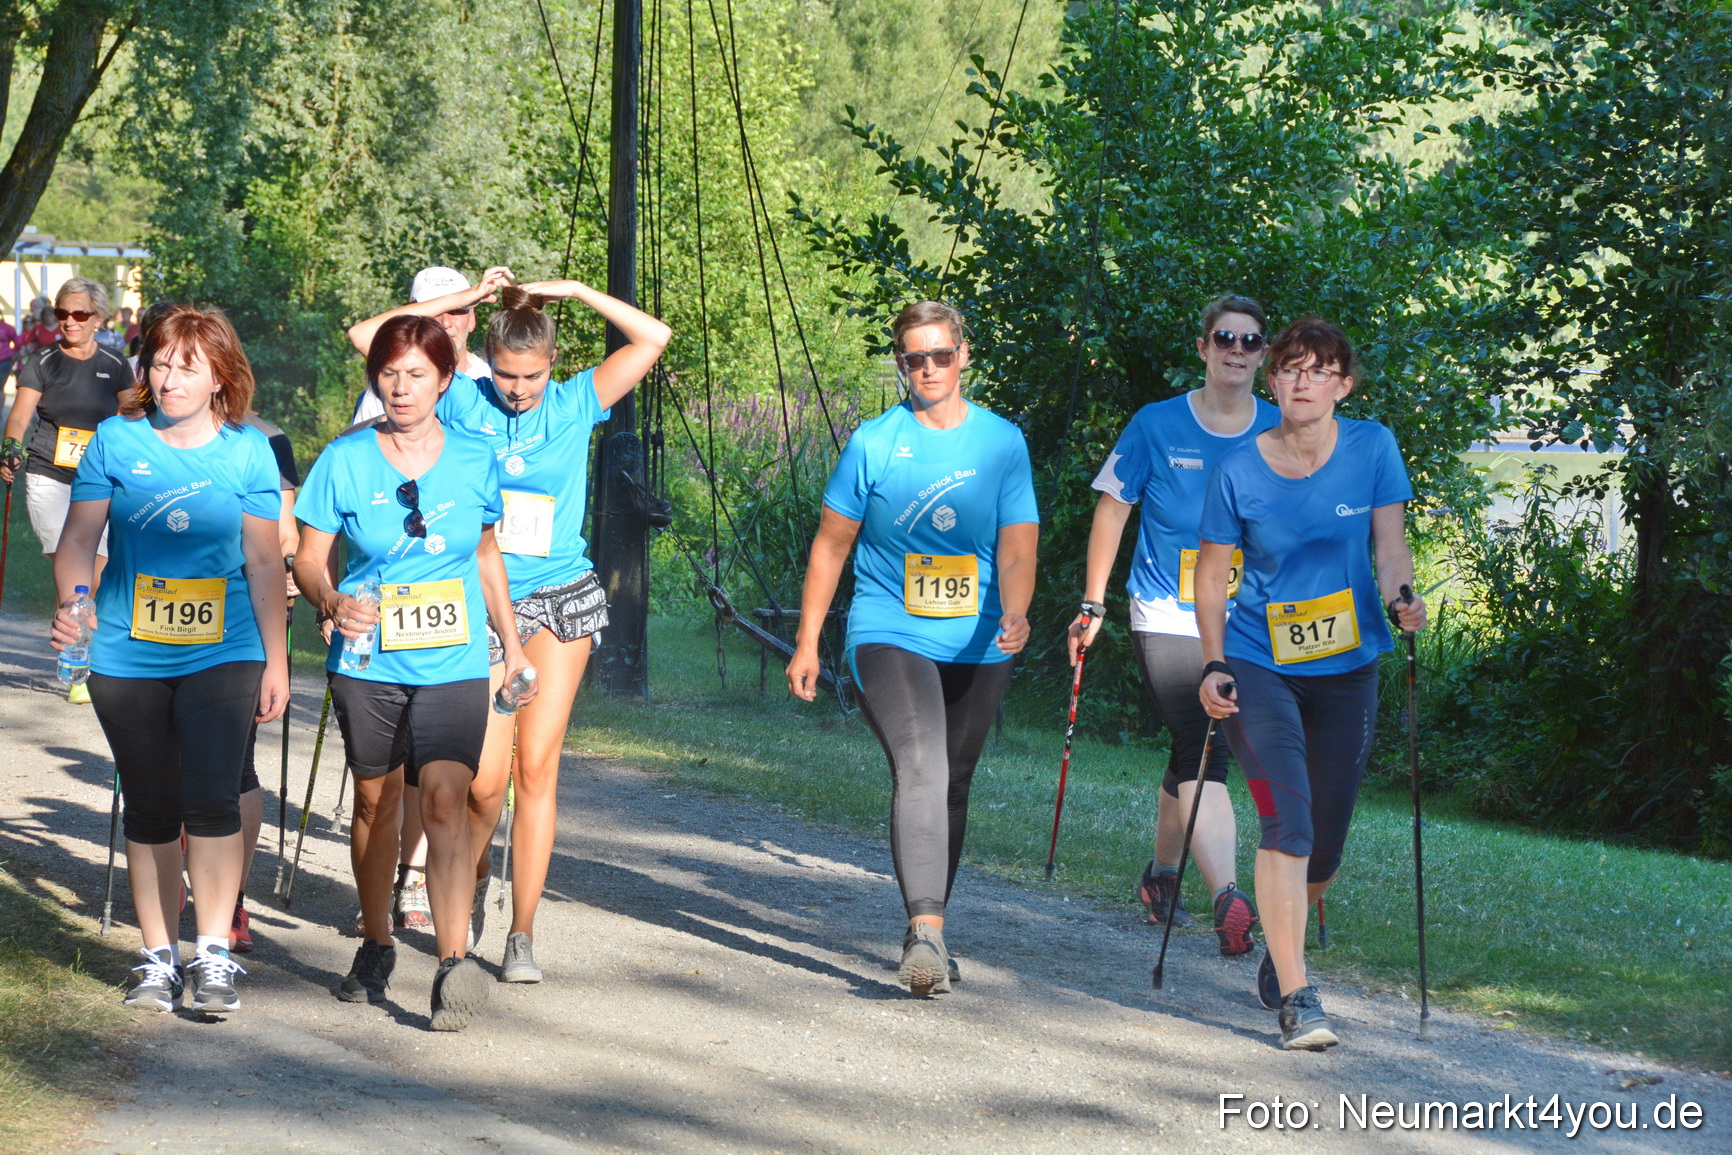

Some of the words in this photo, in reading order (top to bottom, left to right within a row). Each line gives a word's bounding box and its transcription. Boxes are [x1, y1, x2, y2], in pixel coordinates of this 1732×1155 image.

[127, 501, 155, 524] Team
[154, 486, 189, 502] Schick
[190, 478, 212, 490] Bau
[893, 500, 919, 526] Team
[918, 475, 953, 500] Schick
[954, 468, 977, 480] Bau
[387, 532, 409, 556] Team
[436, 500, 456, 512] Bau
[915, 576, 970, 599] 1195
[145, 600, 213, 626] 1196
[392, 603, 458, 630] 1193
[160, 624, 176, 633] Fink
[177, 626, 197, 634] Birgit
[433, 627, 457, 635] Andrea
[1289, 616, 1337, 645] 817
[1298, 643, 1321, 651] Platzer
